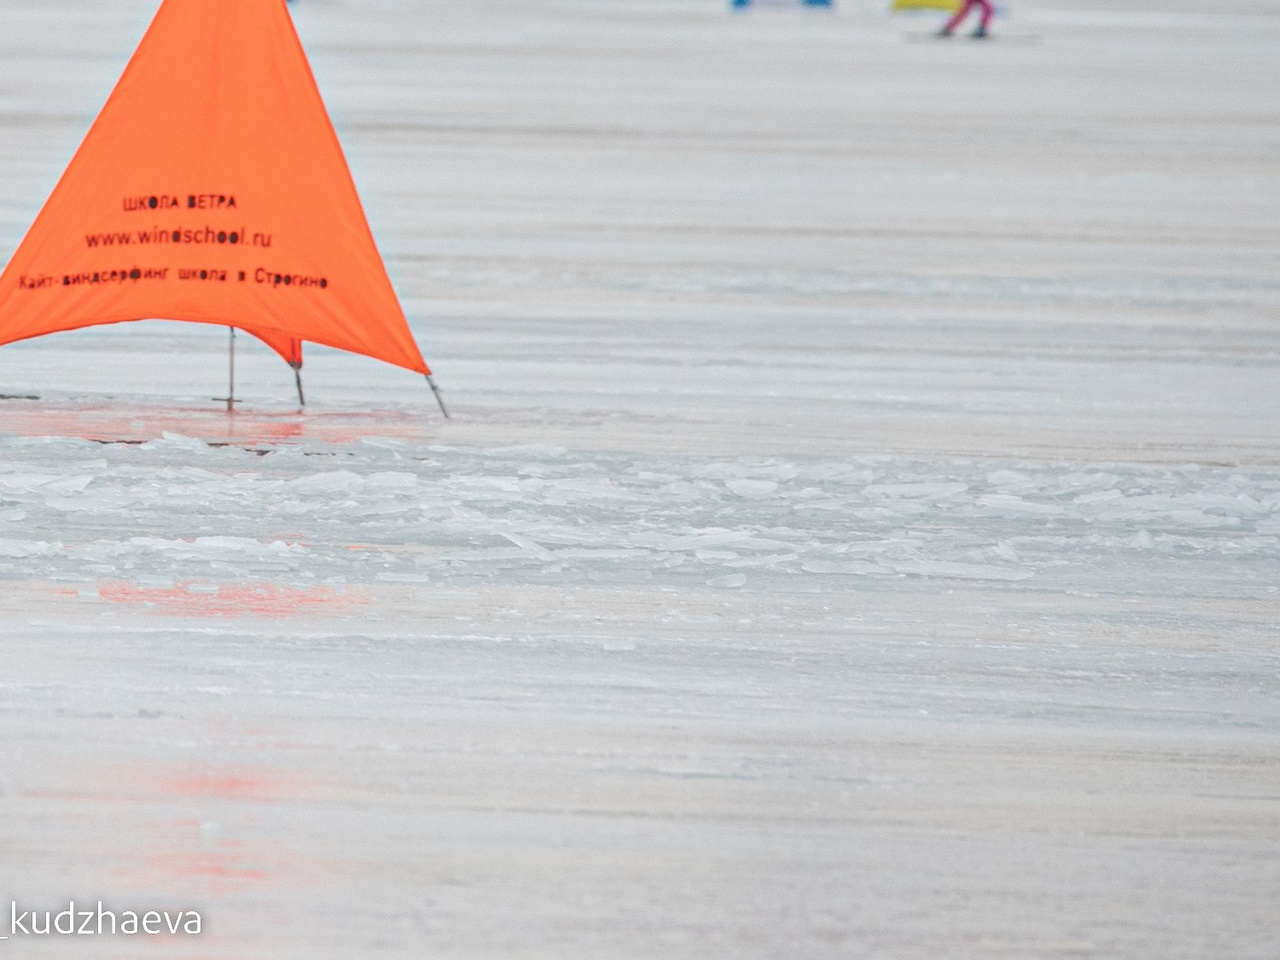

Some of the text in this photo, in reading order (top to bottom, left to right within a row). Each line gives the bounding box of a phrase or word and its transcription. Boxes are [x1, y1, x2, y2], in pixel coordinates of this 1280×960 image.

[123, 194, 236, 211] ШКОЛА ВЕТРА
[86, 225, 271, 248] www.windschool.ru
[19, 266, 328, 290] Кайт-виндсерфинг школа в Строгино
